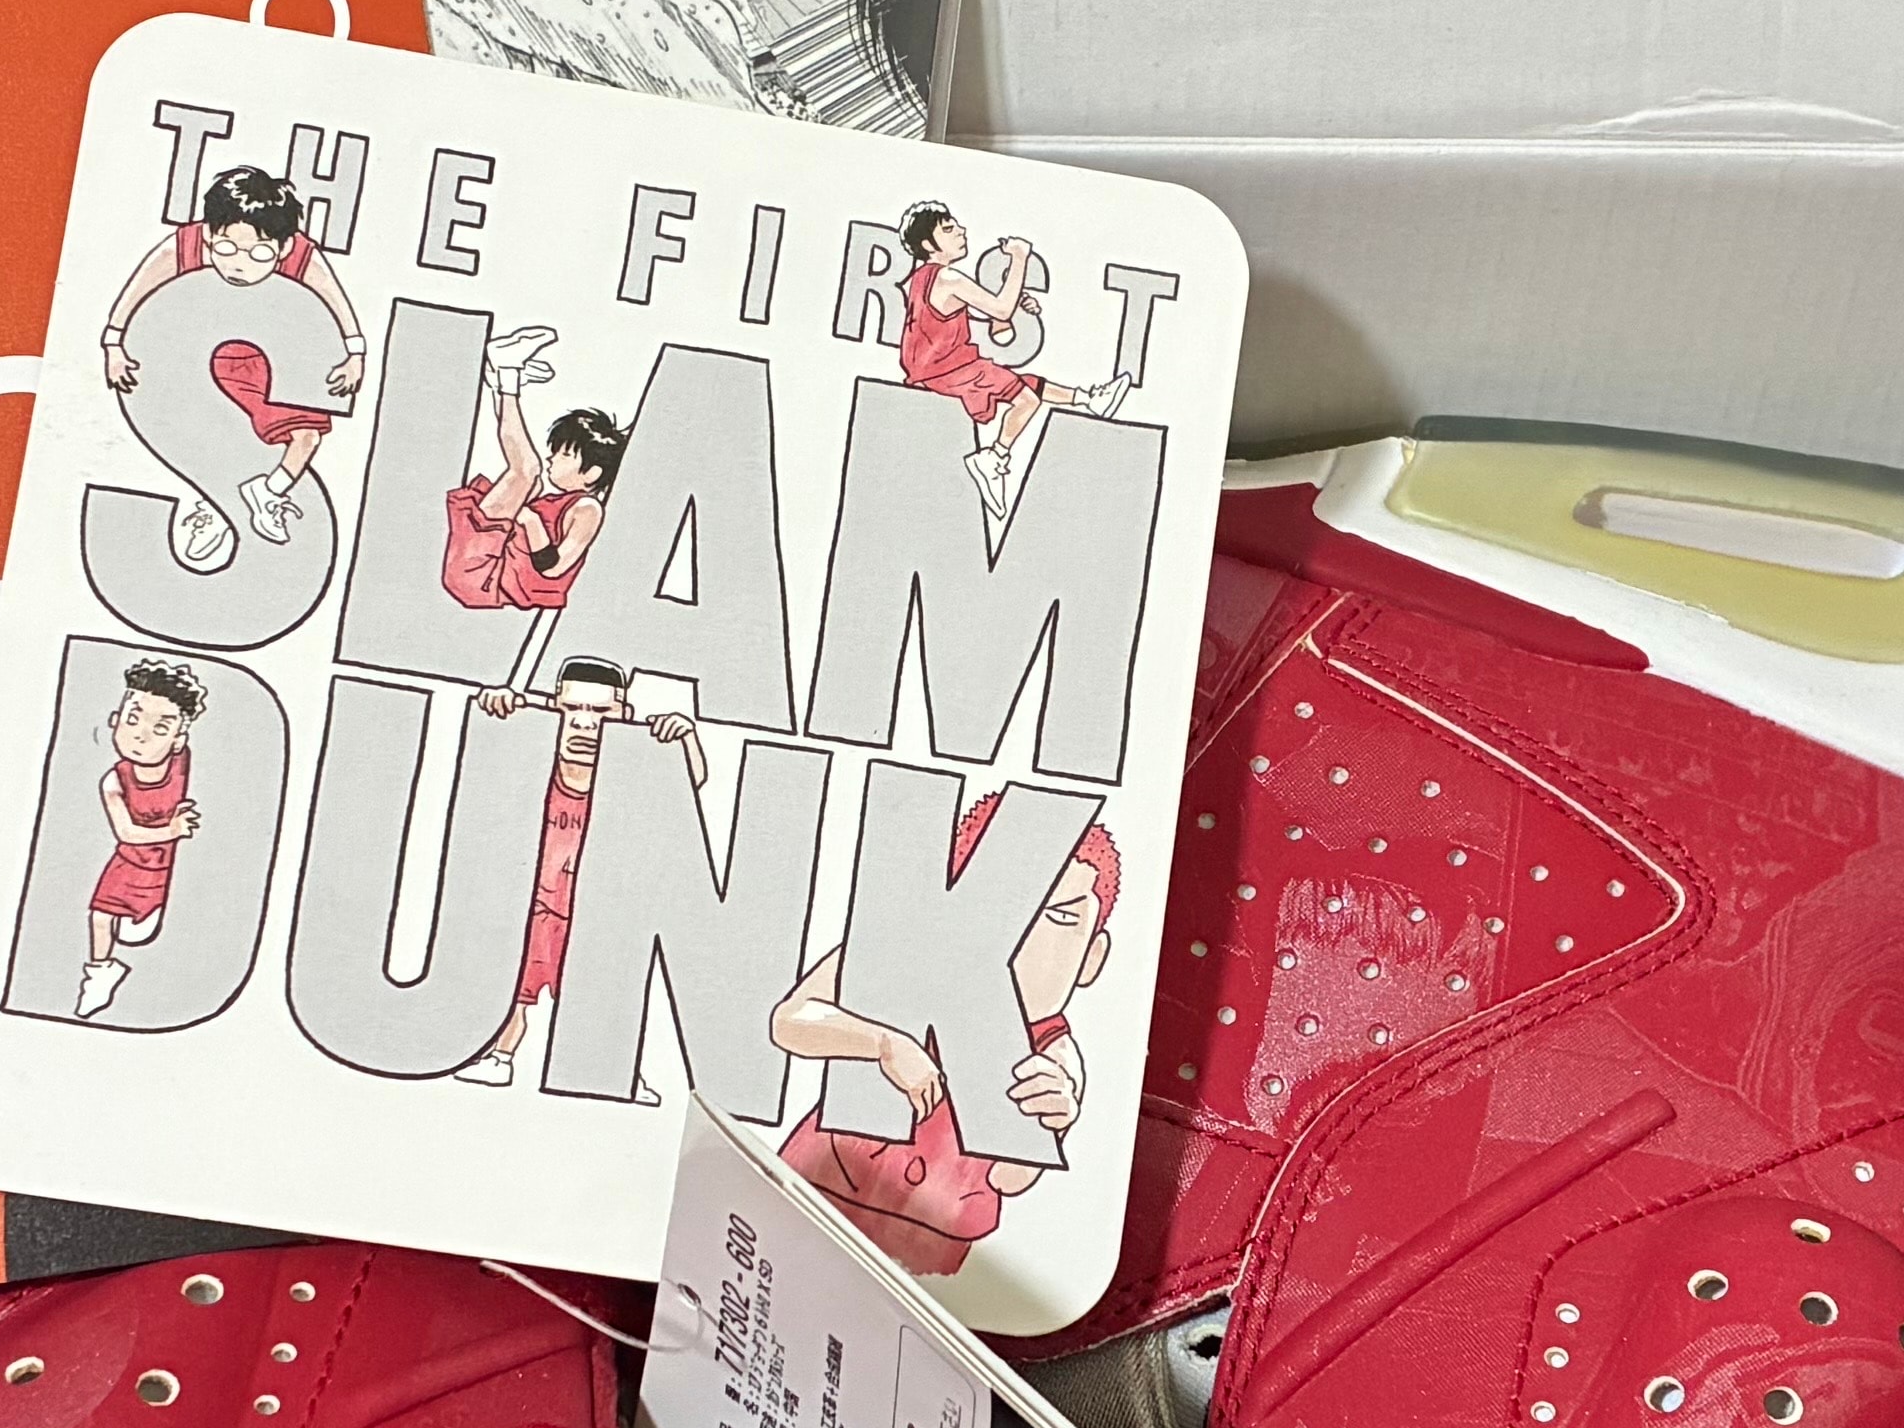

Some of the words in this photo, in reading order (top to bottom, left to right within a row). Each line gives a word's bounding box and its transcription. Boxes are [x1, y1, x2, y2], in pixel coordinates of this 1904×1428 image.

[154, 100, 496, 276] THE
[616, 184, 1180, 389] FIRST
[81, 267, 1170, 786] SLAM
[0, 635, 1108, 1171] DUNK
